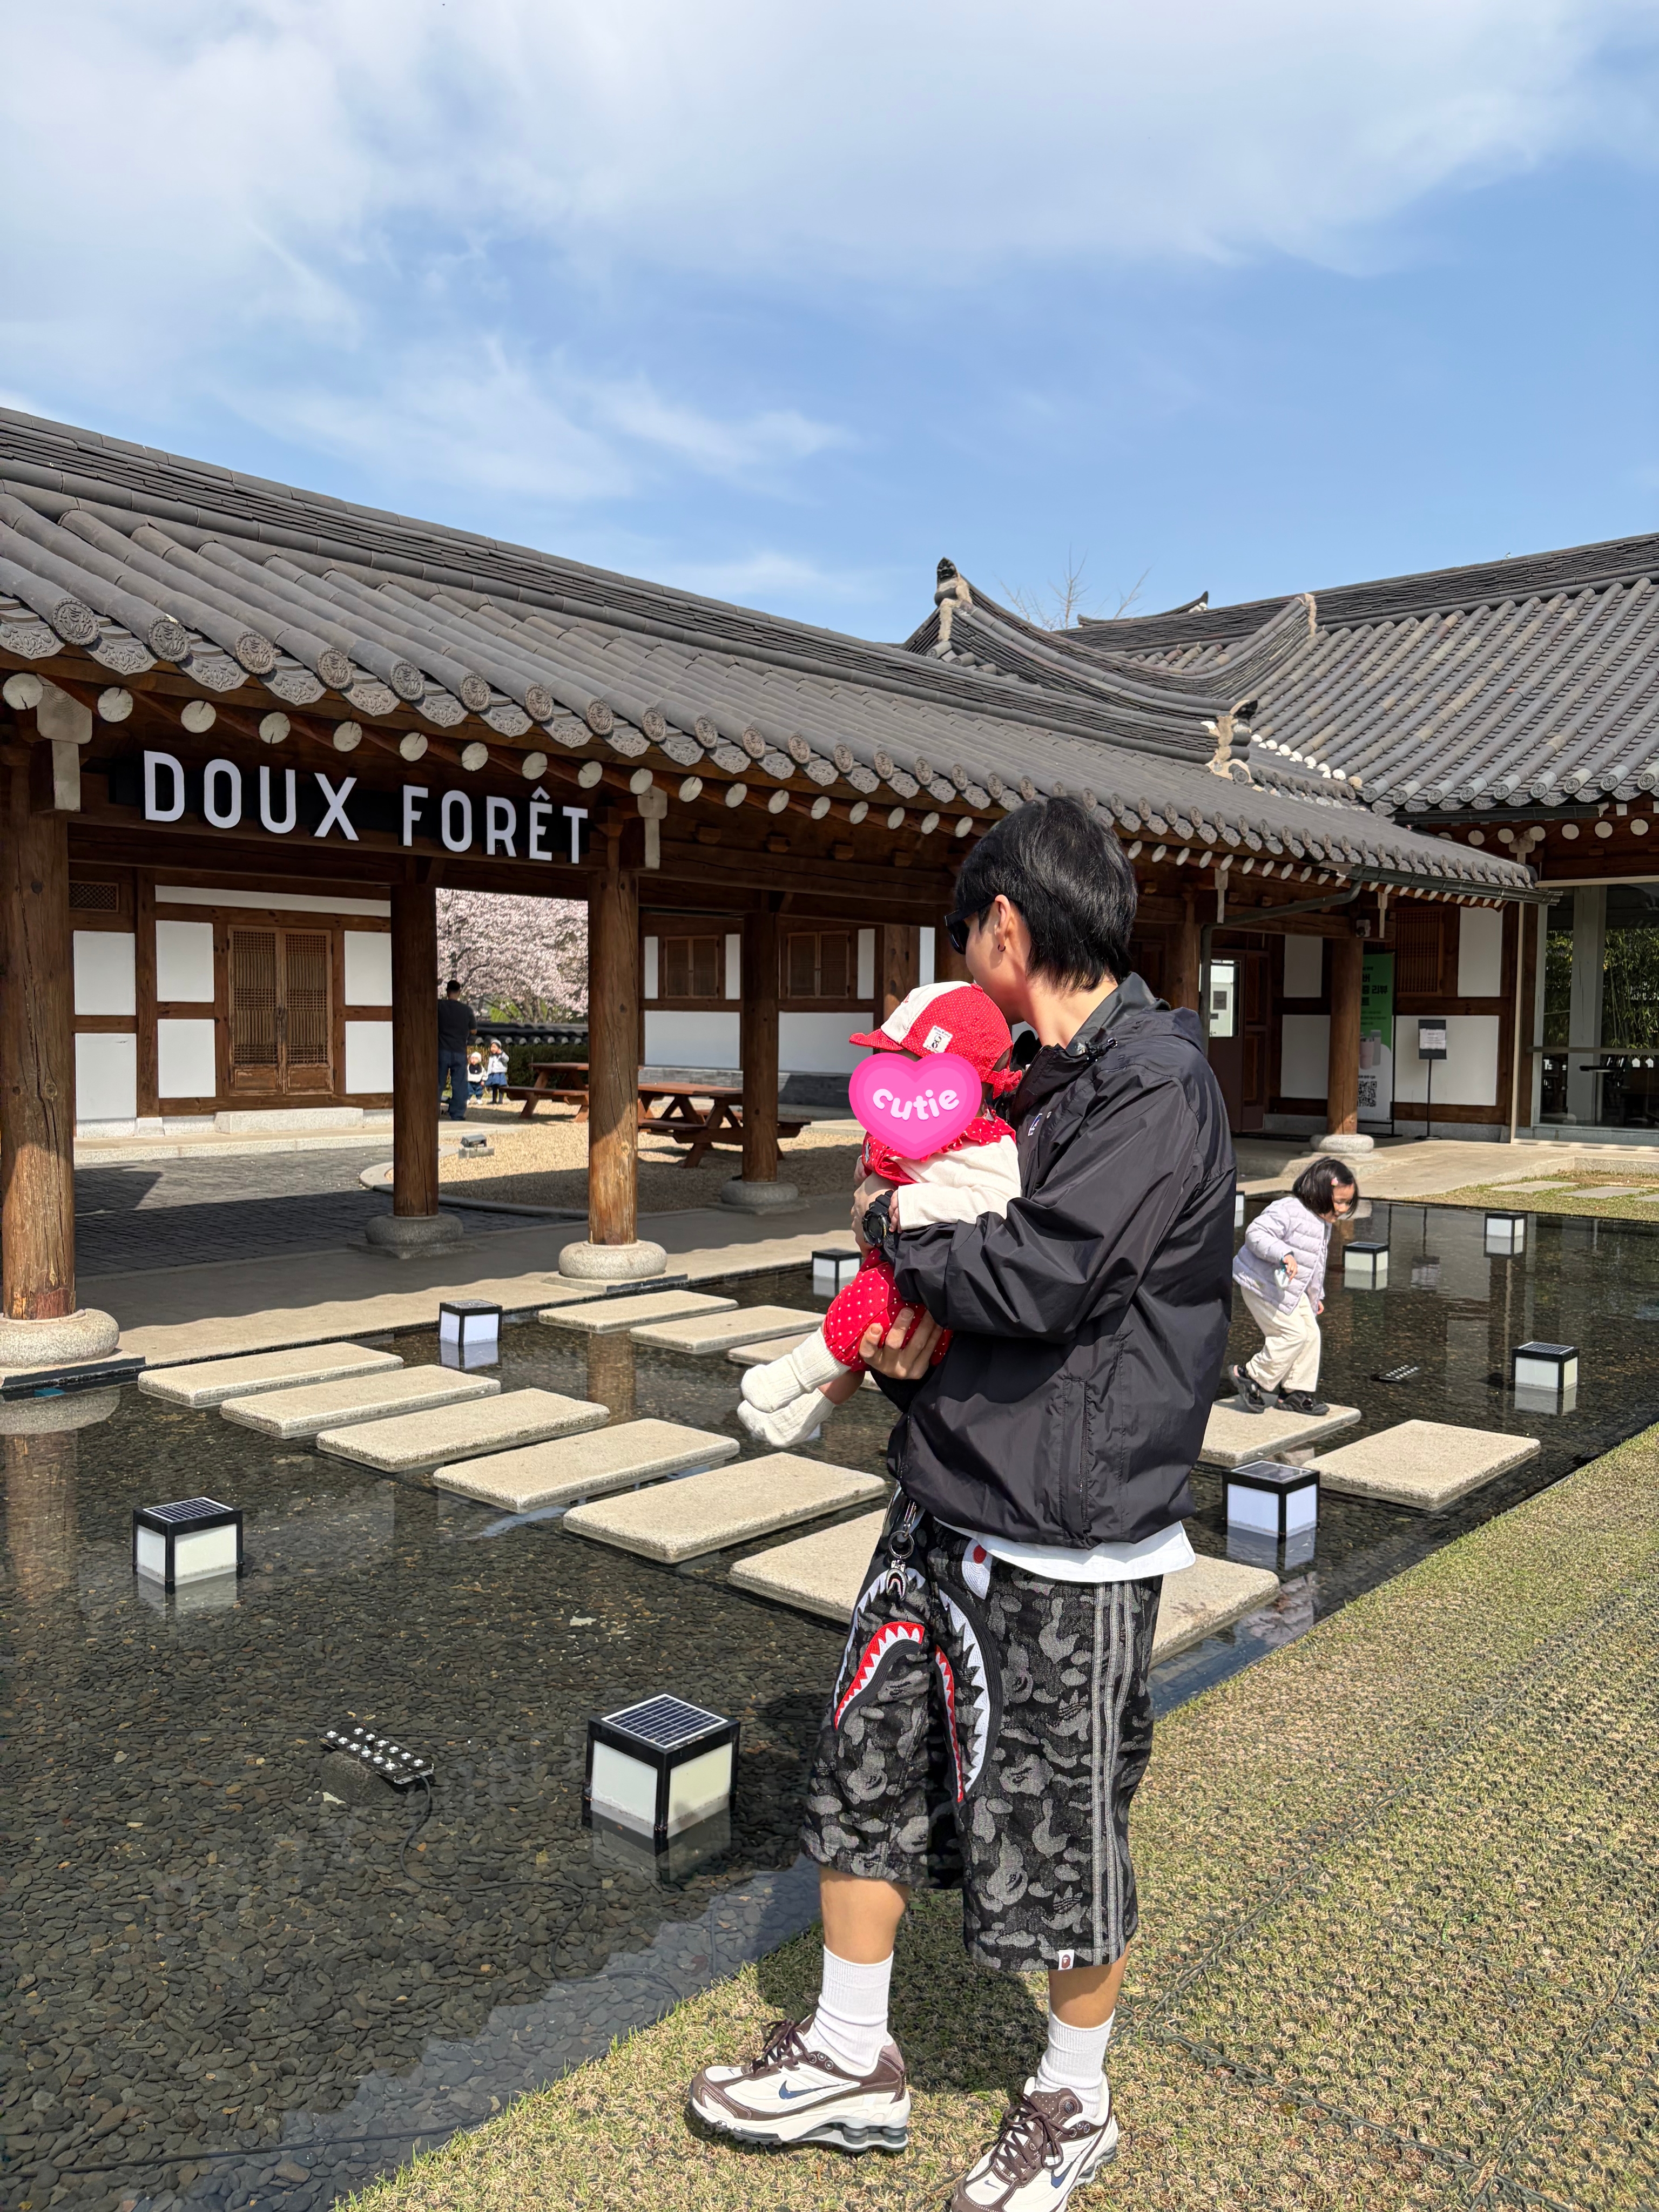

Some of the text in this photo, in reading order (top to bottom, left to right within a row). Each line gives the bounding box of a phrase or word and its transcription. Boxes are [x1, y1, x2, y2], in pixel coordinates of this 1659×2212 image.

[144, 750, 589, 864] DOUX FORÊT
[1372, 985, 1388, 994] 리뷰
